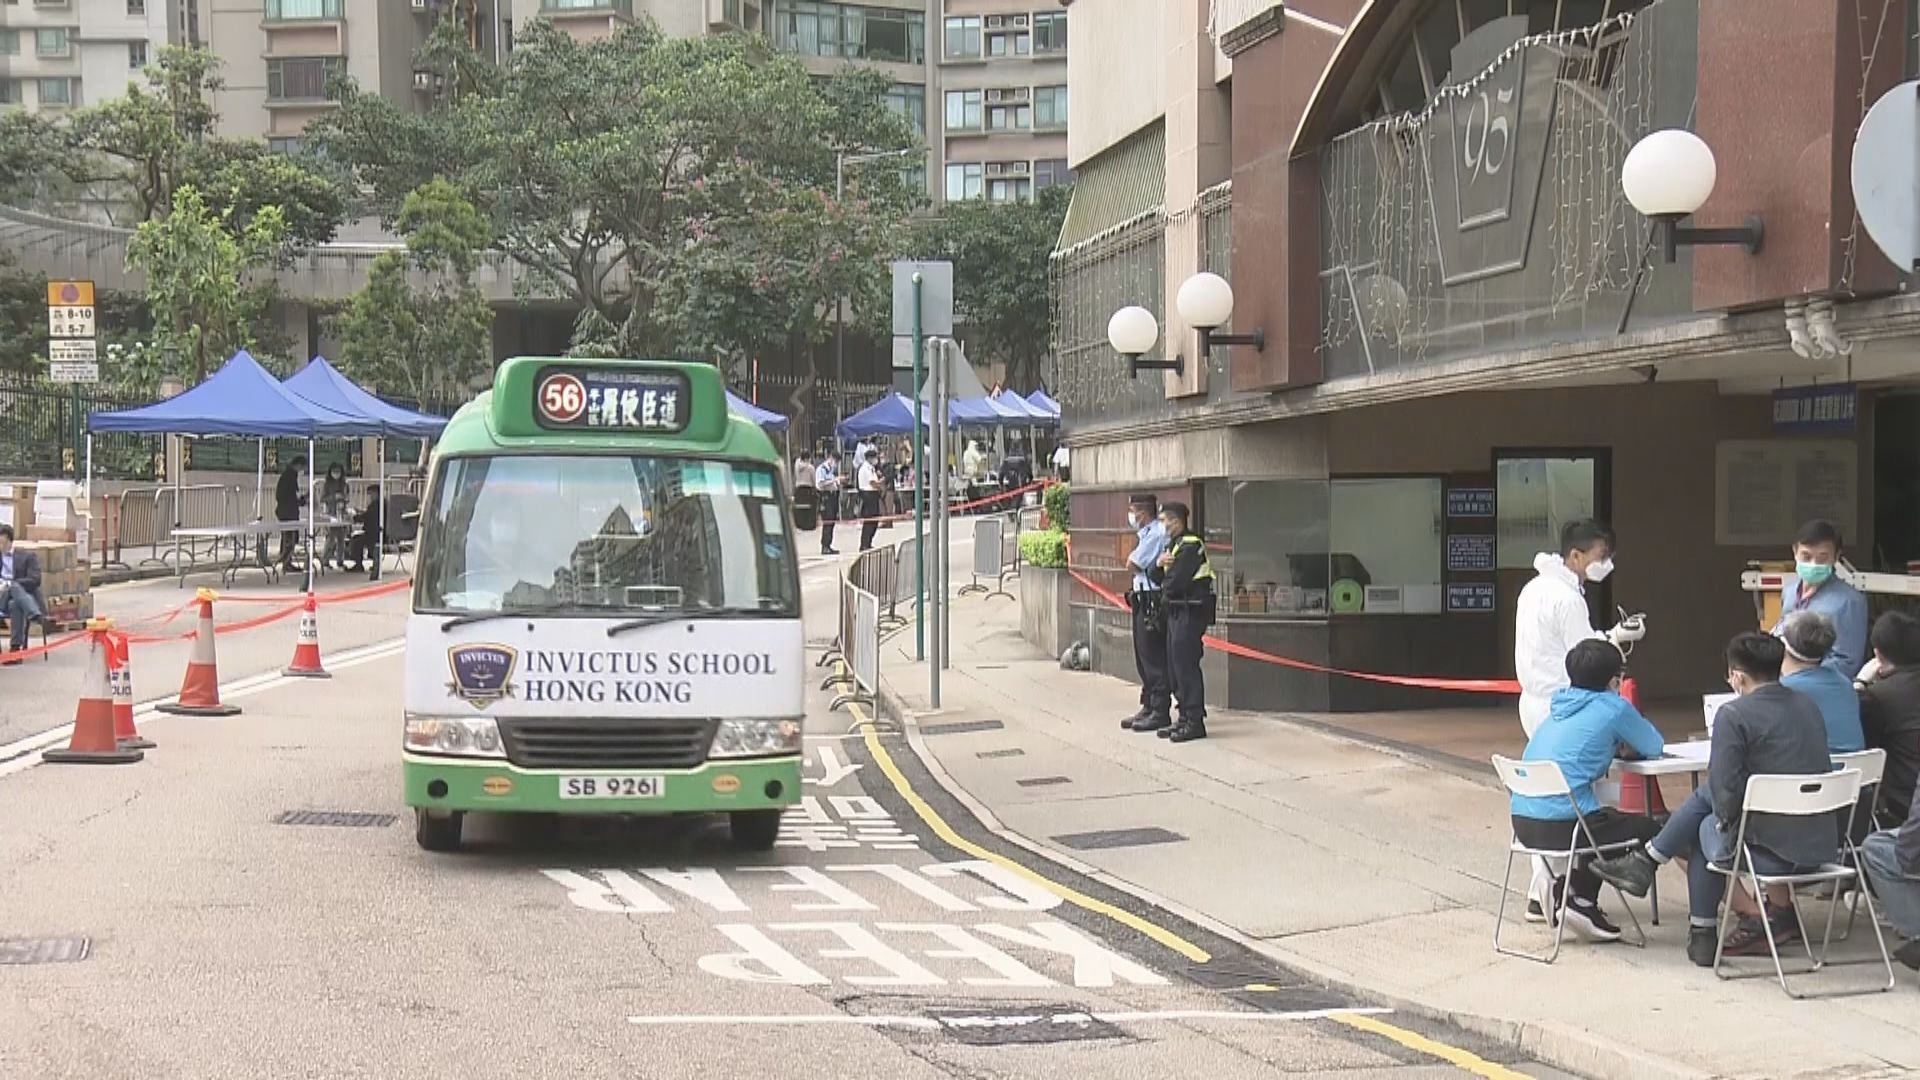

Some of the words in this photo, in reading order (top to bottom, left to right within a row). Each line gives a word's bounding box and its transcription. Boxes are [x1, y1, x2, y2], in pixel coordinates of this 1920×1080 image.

[545, 383, 580, 413] 56
[460, 651, 506, 665] INVICTUS
[525, 650, 658, 674] INVICTUS
[668, 652, 777, 676] SCHOOL
[111, 685, 132, 696] OLIC
[525, 680, 605, 702] HONG
[615, 681, 692, 703] KONG
[567, 778, 596, 797] SB
[607, 777, 657, 797] 9261
[540, 859, 1066, 913] CLEAR
[697, 922, 1172, 988] KEEP
